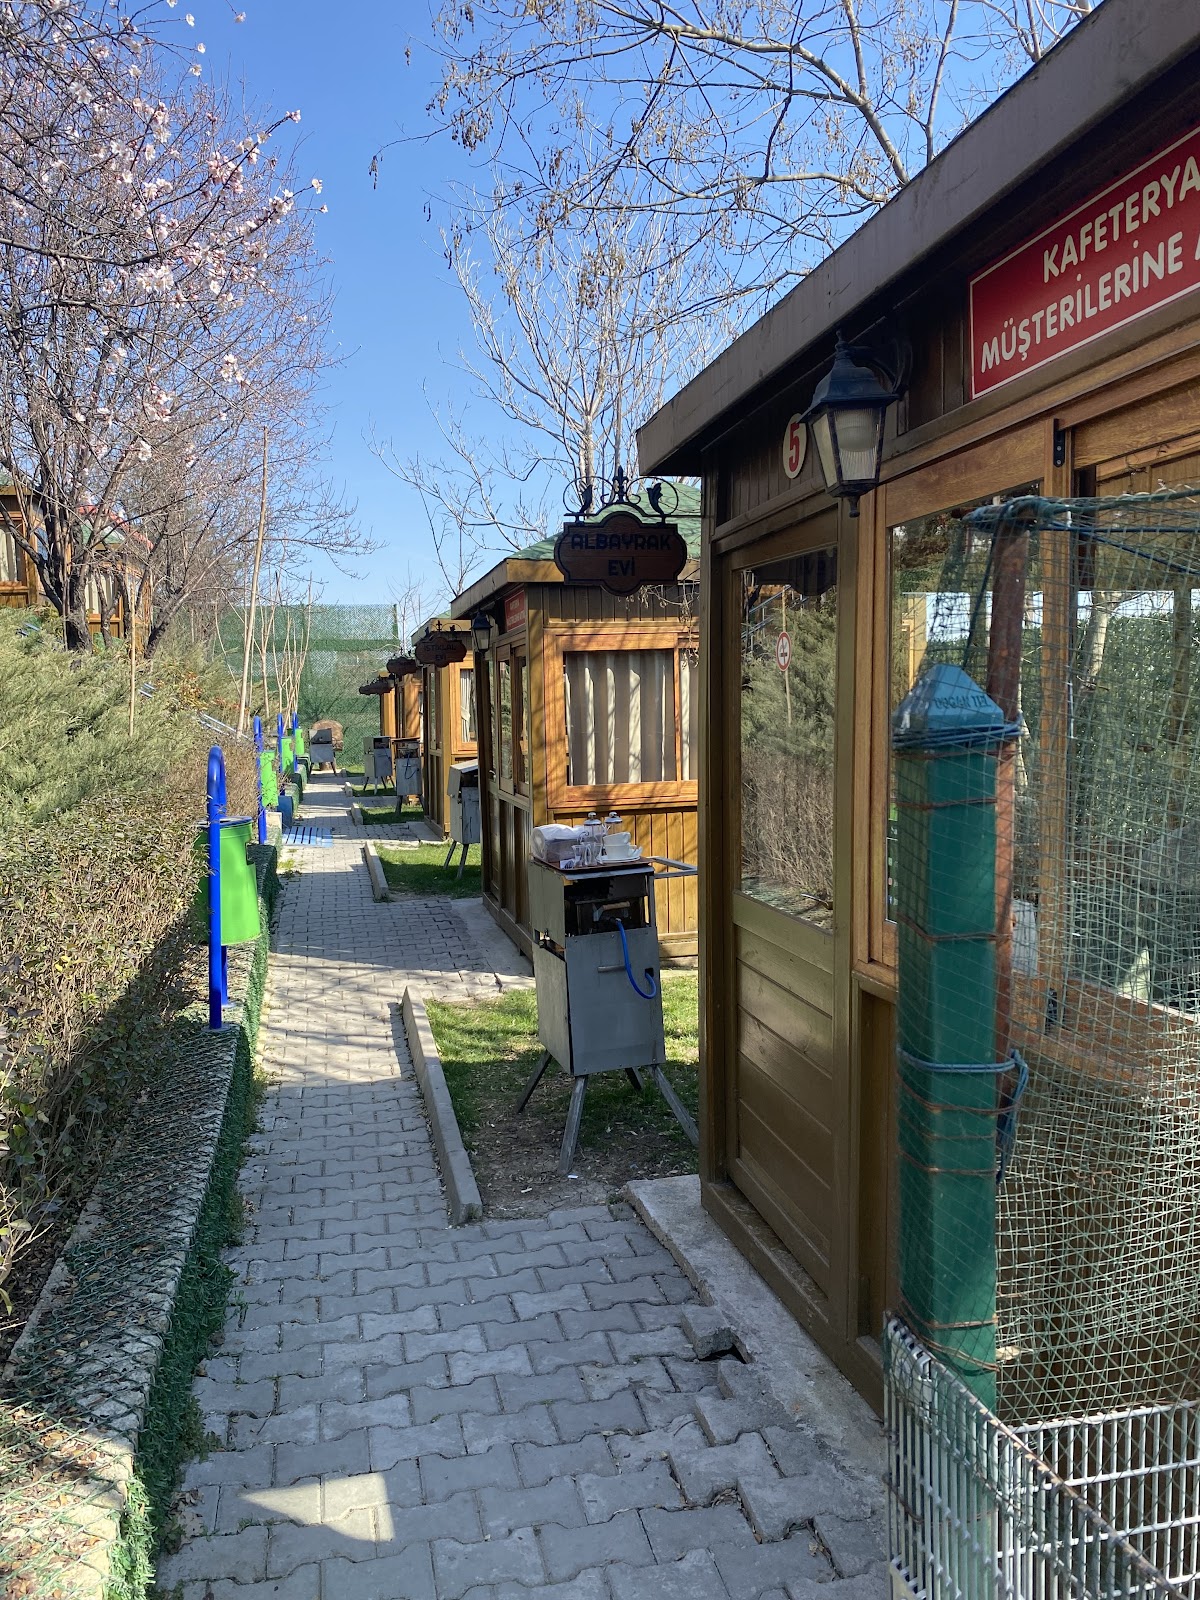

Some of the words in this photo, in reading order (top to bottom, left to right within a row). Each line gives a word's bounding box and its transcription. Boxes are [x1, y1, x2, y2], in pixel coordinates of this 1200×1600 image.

[1043, 156, 1200, 283] KAFETERYA
[981, 231, 1184, 374] MÜŞTERİLERİNE
[788, 421, 800, 473] 5
[571, 533, 671, 551] ALBAYRAK
[608, 556, 635, 577] EVİ
